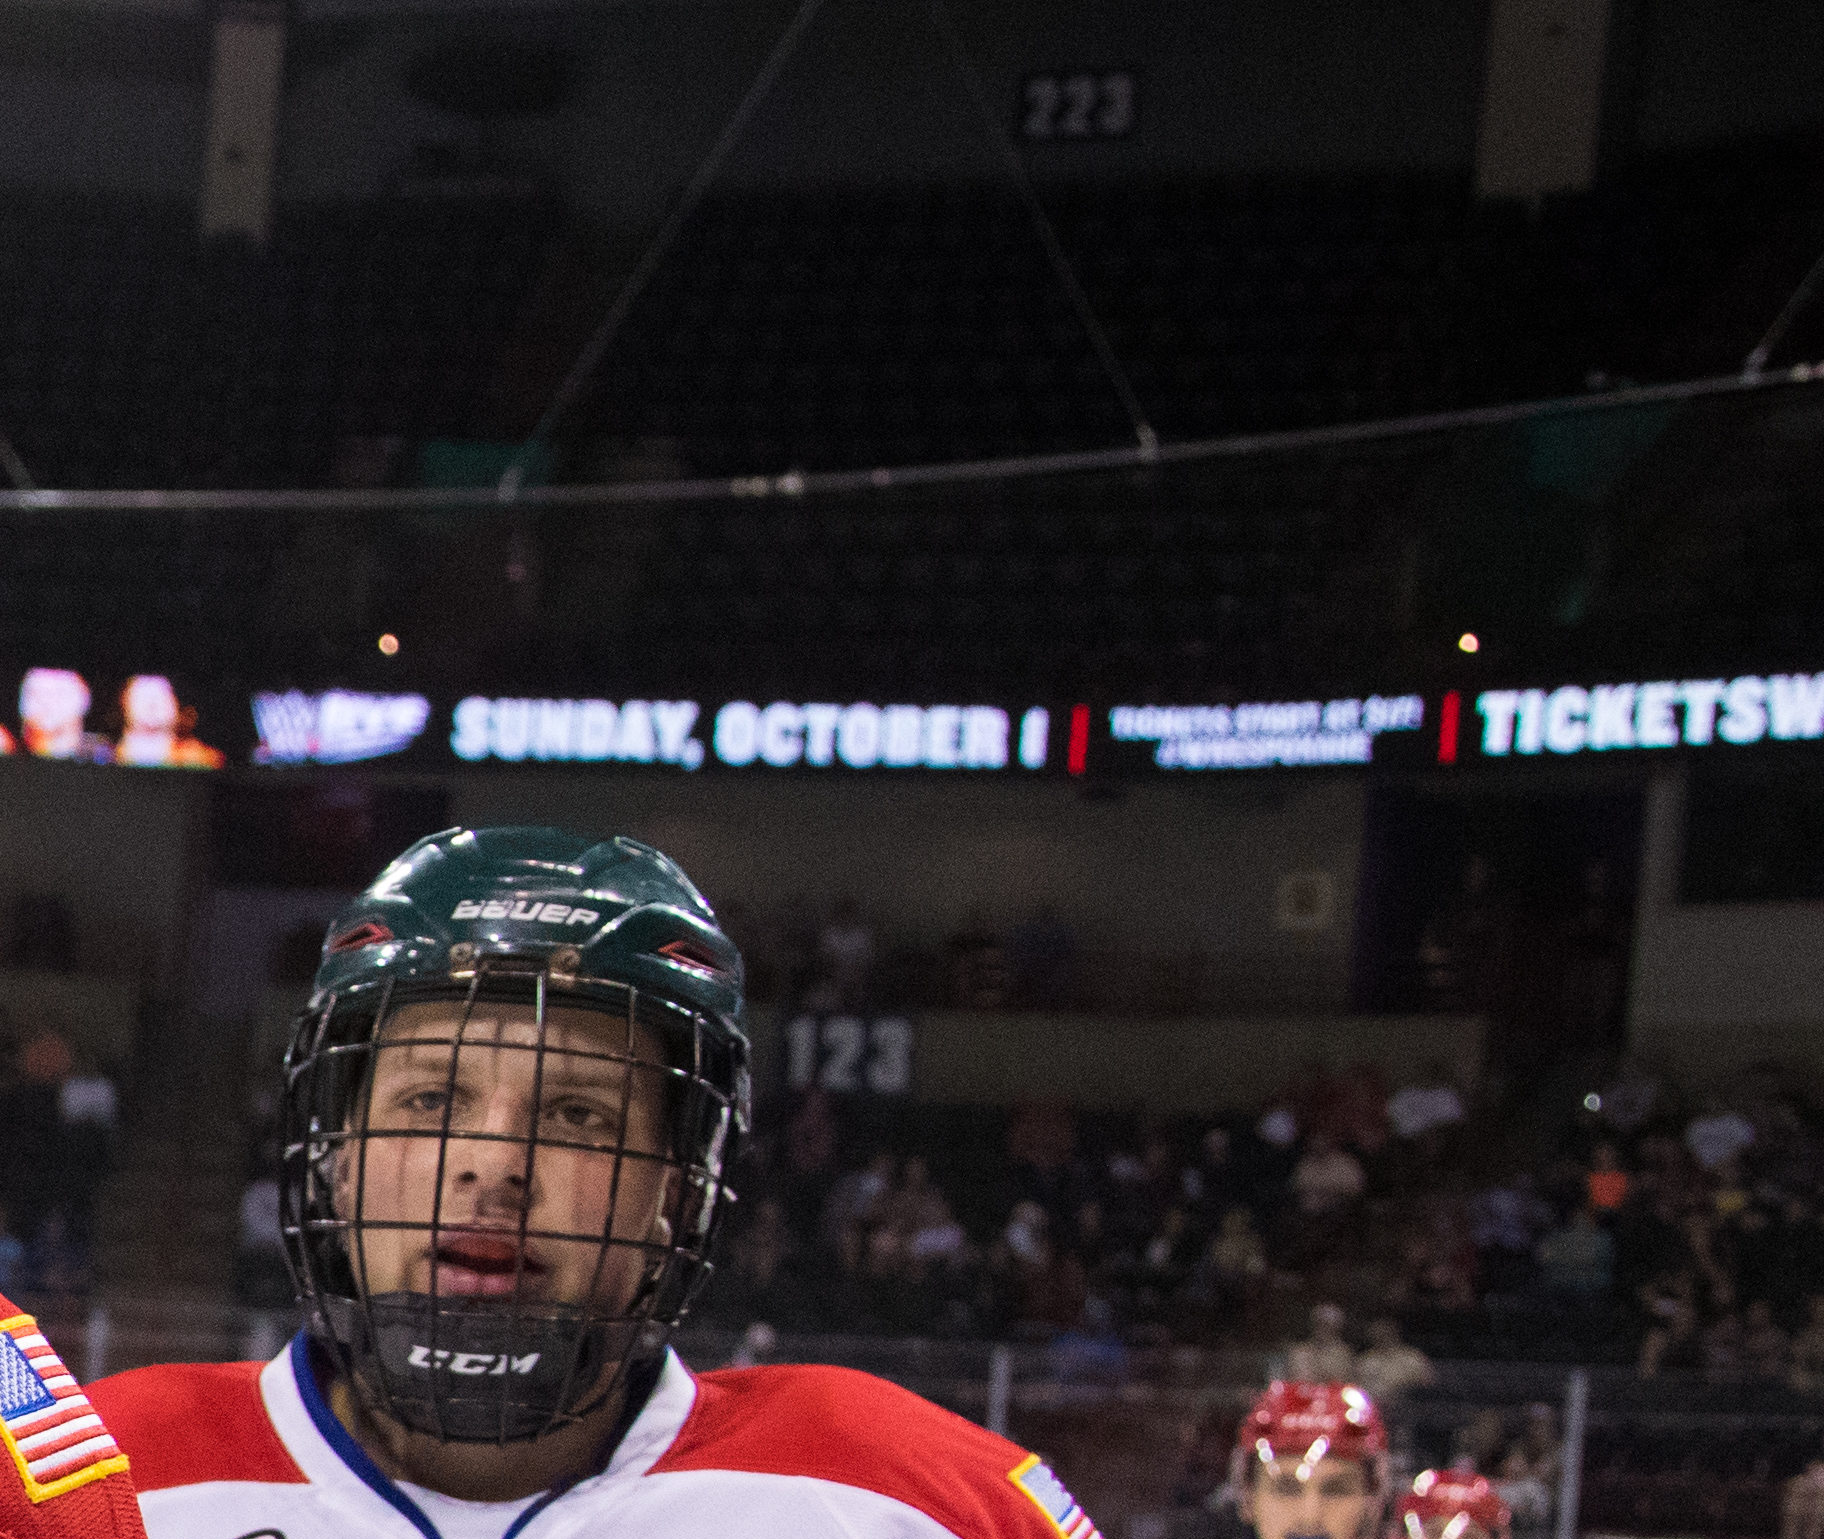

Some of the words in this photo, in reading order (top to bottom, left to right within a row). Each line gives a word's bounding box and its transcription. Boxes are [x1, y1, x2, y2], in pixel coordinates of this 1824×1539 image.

[1024, 74, 1134, 137] 223
[451, 696, 705, 771] SUNDAY,
[713, 699, 1010, 769] OCTOBER
[452, 899, 601, 926] BAUER
[785, 1017, 915, 1094] 123
[407, 1344, 542, 1375] CCM
